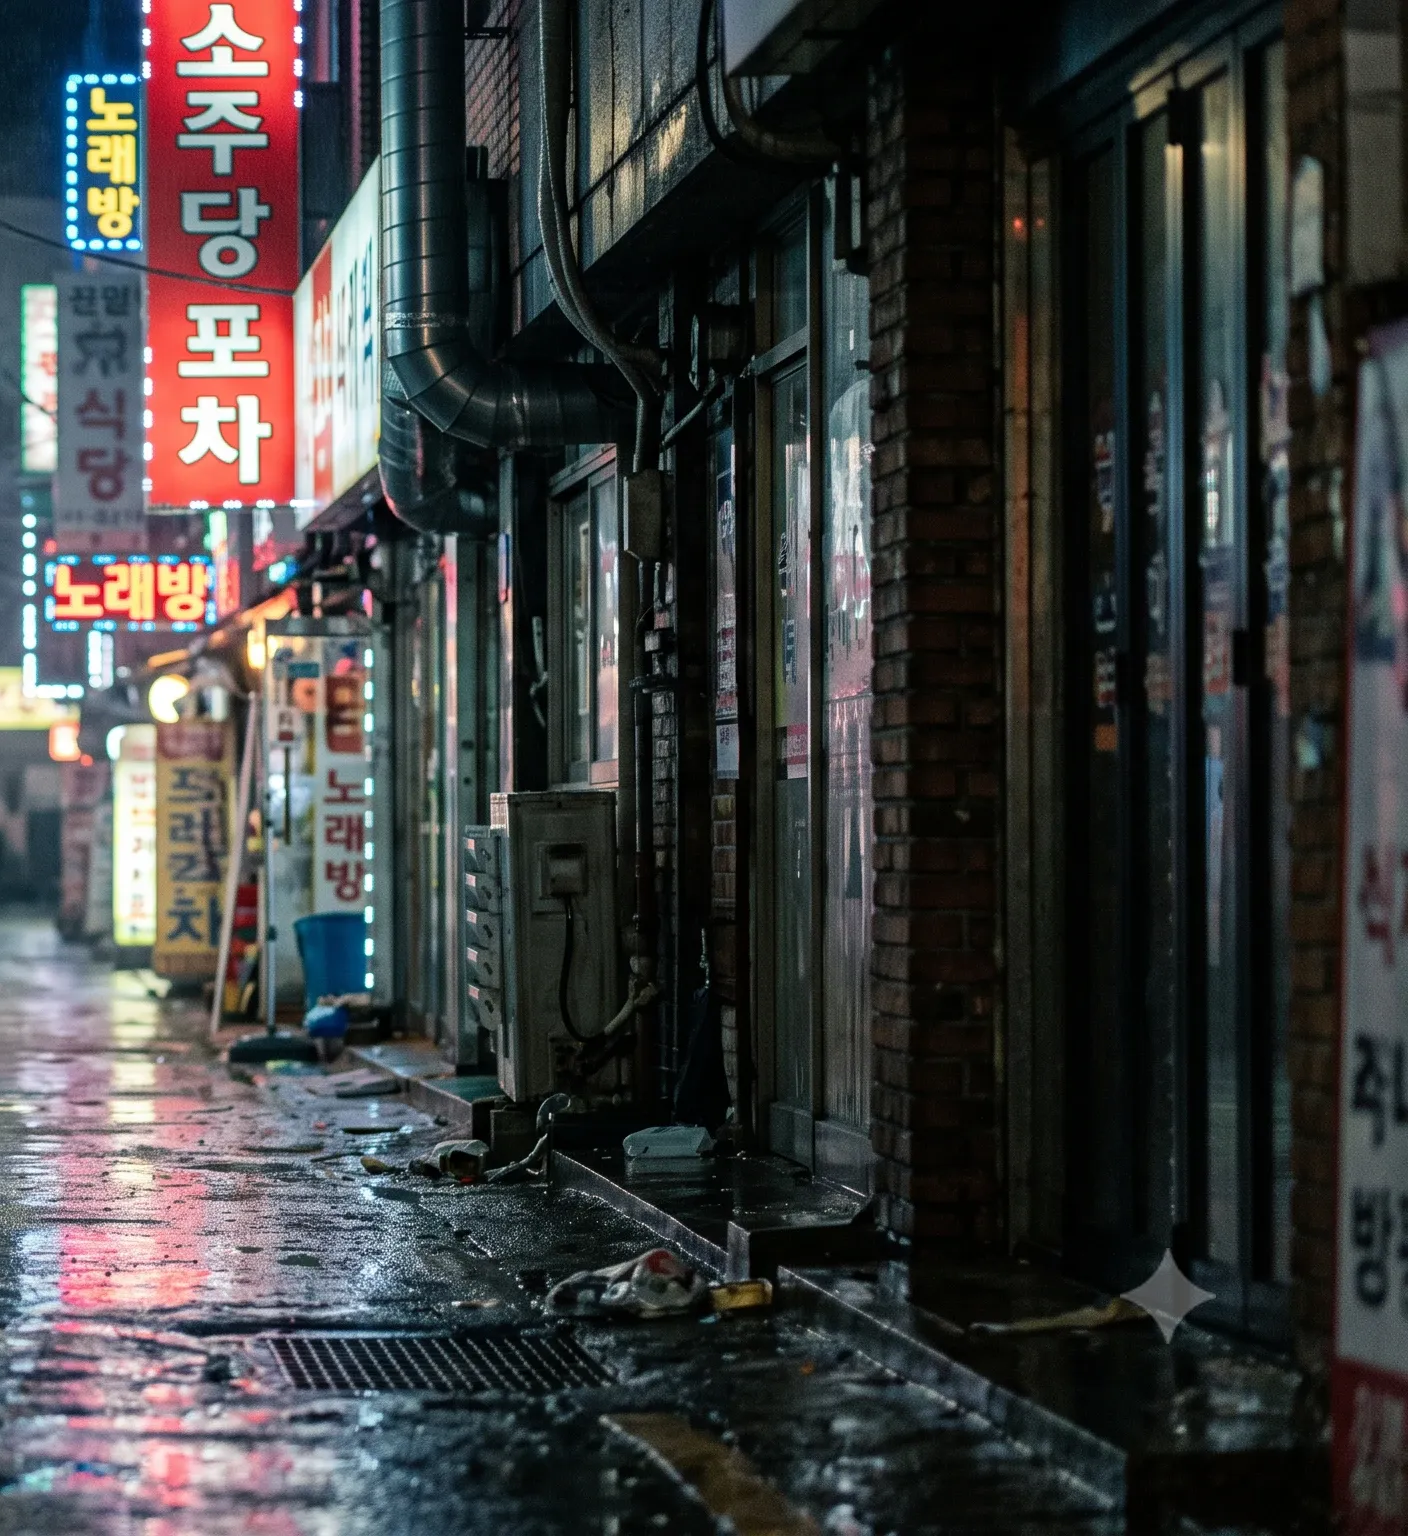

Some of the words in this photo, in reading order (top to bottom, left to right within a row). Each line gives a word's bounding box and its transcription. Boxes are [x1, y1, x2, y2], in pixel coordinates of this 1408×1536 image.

[85, 87, 141, 239] 노래방
[176, 3, 273, 485] 소주당포차
[55, 562, 208, 620] 노래방
[323, 768, 366, 902] 노래방
